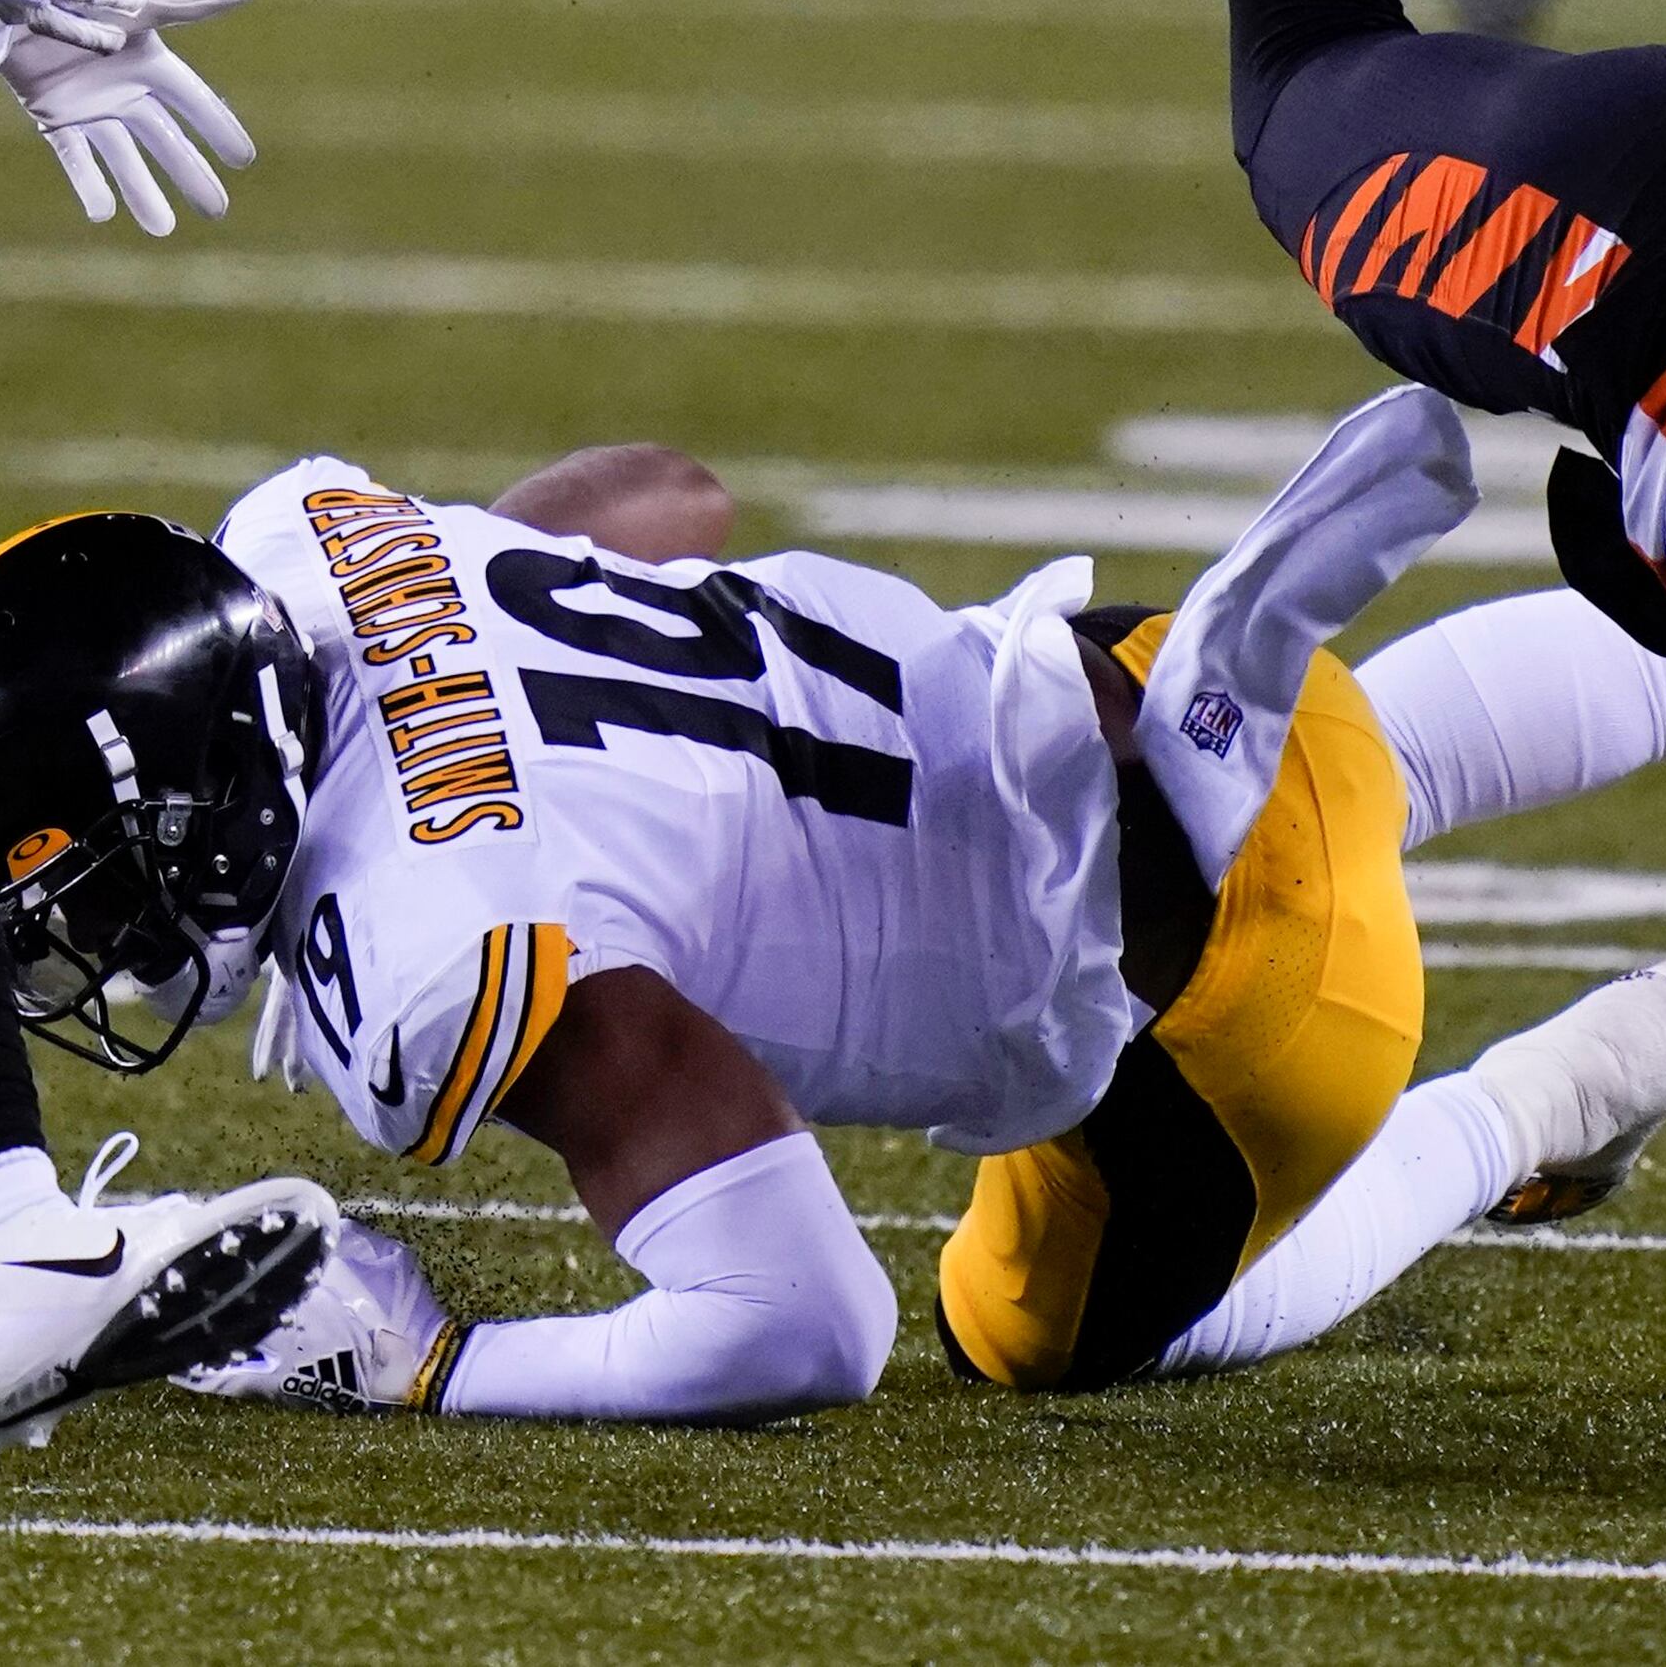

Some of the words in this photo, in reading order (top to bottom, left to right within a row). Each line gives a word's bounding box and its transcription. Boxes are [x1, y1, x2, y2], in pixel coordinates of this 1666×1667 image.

[302, 487, 525, 847] SMITH-SCHUSTER
[483, 547, 915, 830] 19
[295, 892, 364, 1072] 19
